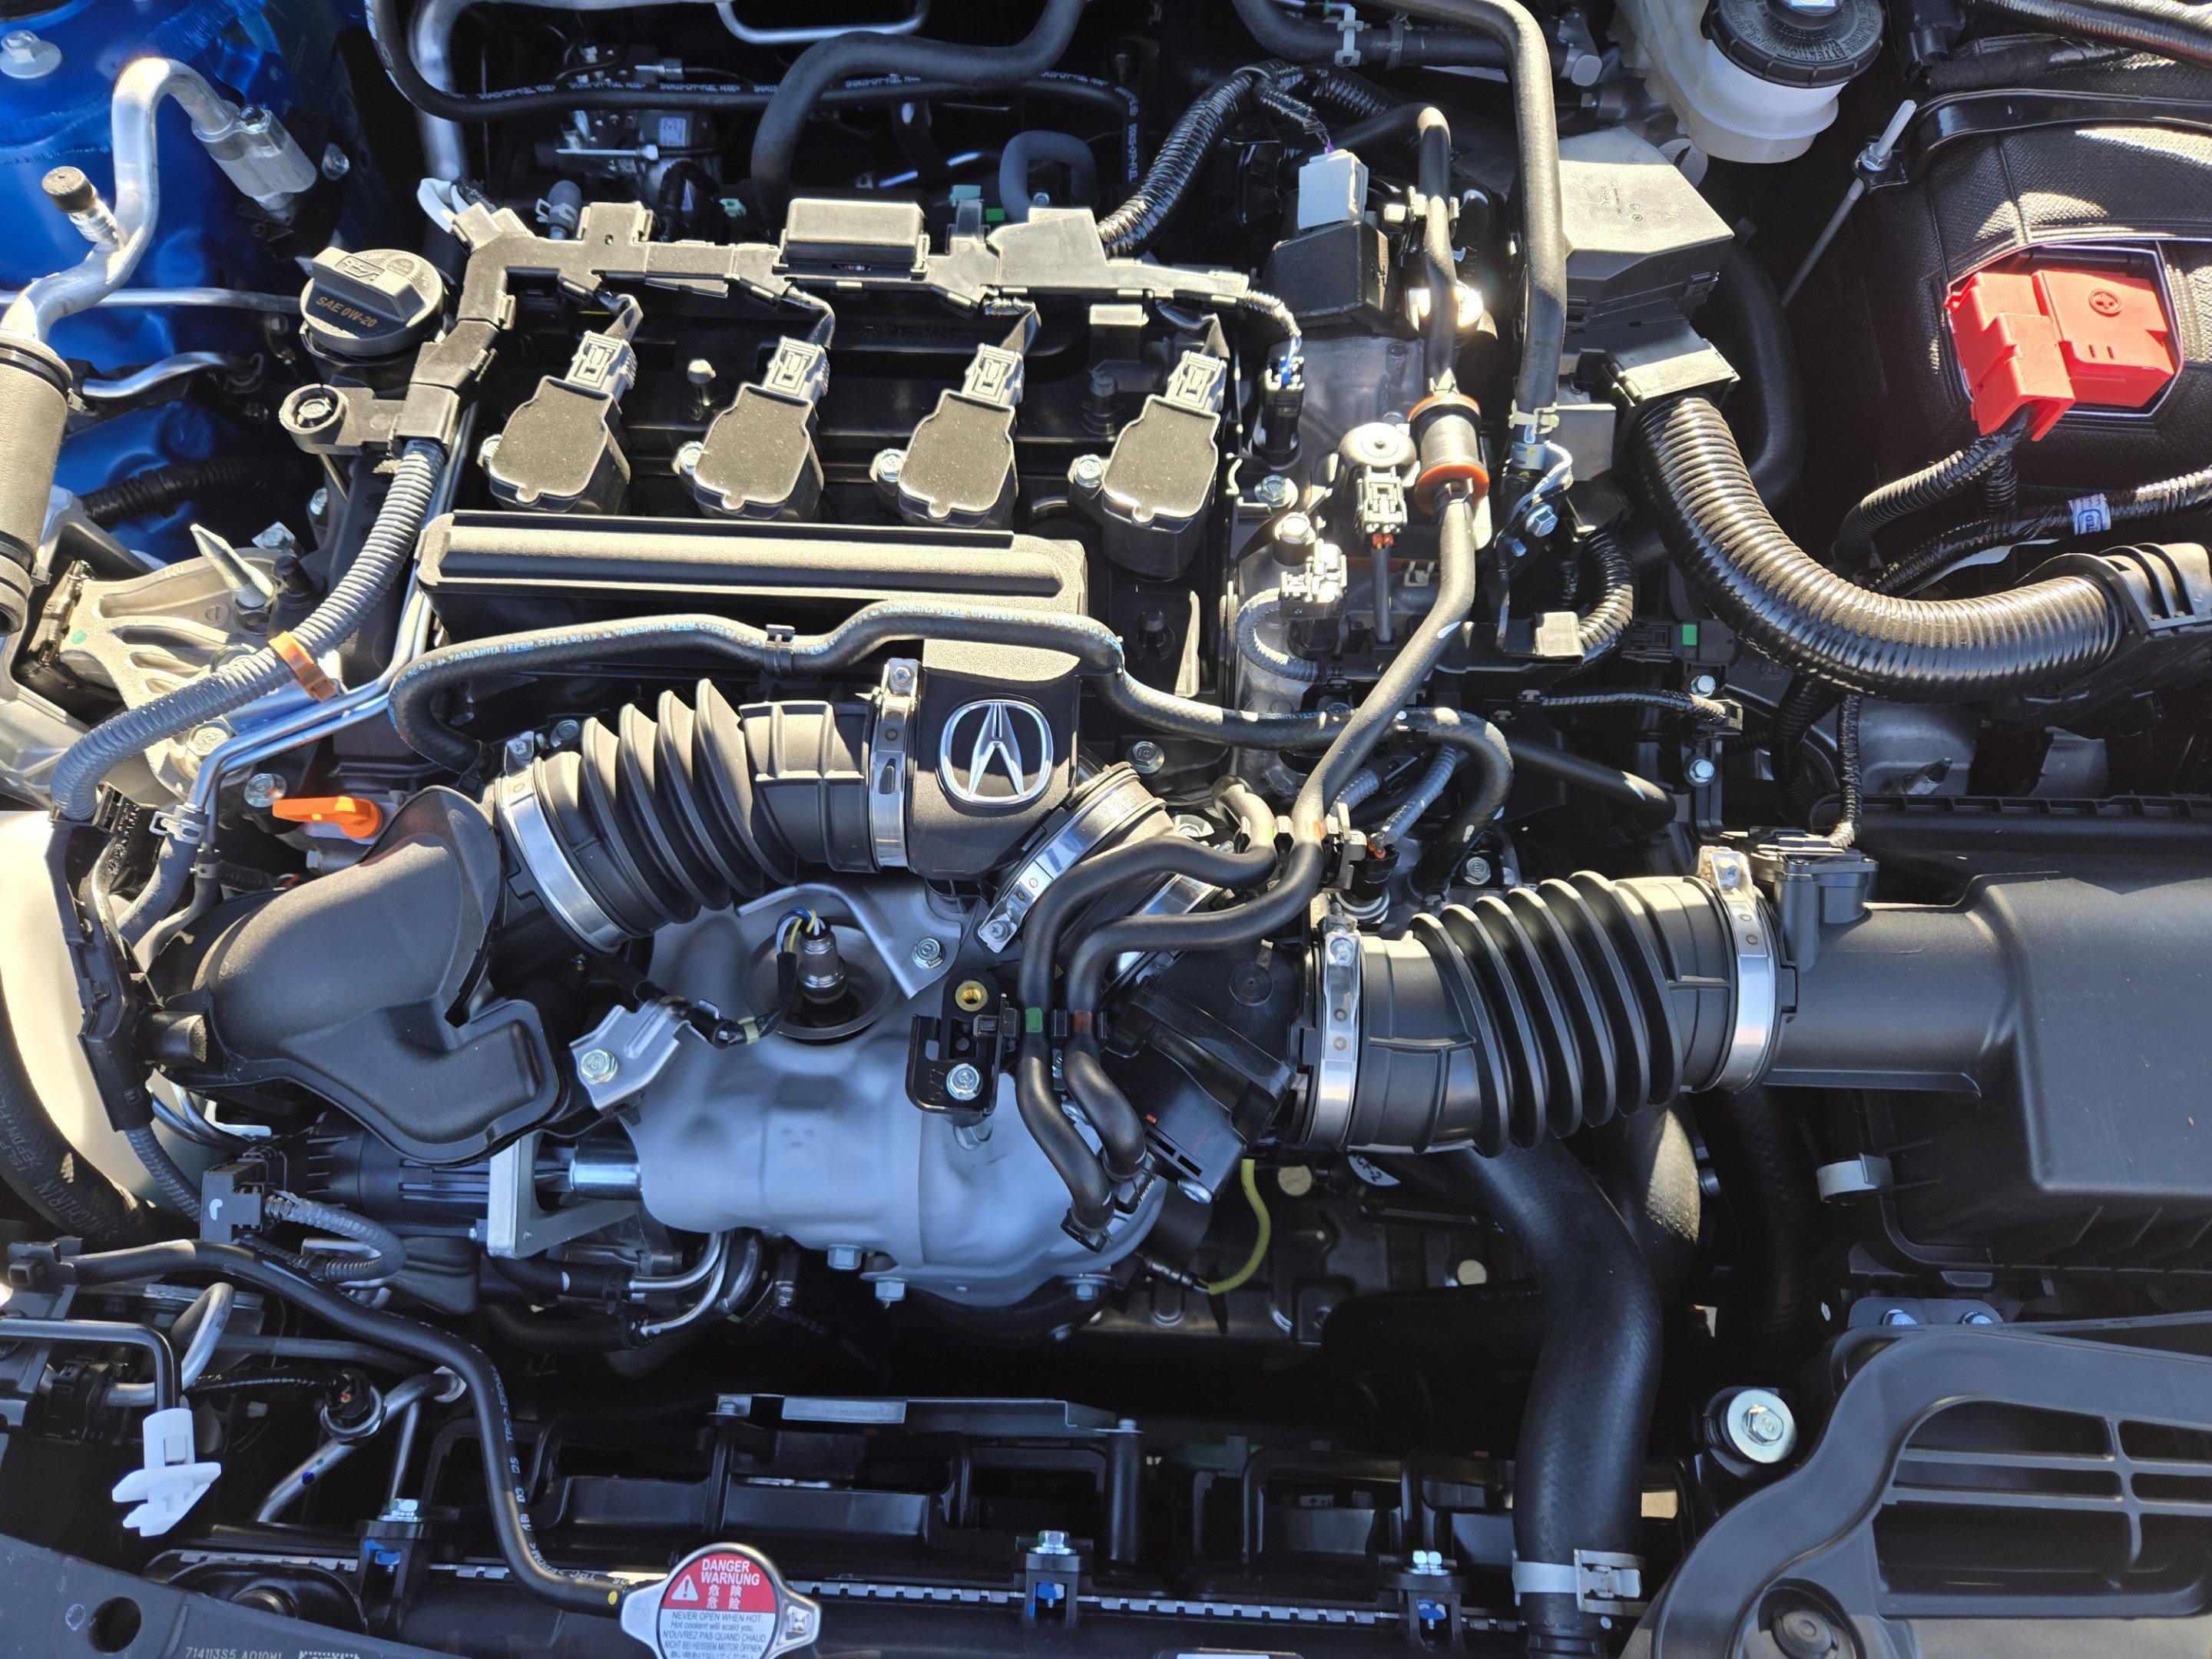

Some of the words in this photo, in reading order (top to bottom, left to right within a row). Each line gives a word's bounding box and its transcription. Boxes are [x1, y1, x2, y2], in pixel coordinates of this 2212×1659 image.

[316, 296, 344, 313] SAE
[340, 307, 379, 328] 0W-20
[882, 606, 935, 614] YAMASHITA
[448, 646, 501, 663] YAMASHITA
[614, 623, 666, 637] YAMASHITA
[701, 1558, 750, 1573] DANGER
[701, 1571, 760, 1586] WARNUNG
[672, 1611, 697, 1621] NEVER
[700, 1612, 720, 1622] OPEN
[722, 1614, 744, 1622] WHEN
[746, 1614, 763, 1624] HOT.
[684, 1621, 707, 1630] coolant
[723, 1623, 739, 1632] scald
[740, 1625, 754, 1634] you.
[663, 1630, 698, 1641] N'OUVREZ
[700, 1631, 714, 1641] PAS
[715, 1632, 740, 1642] QUAND
[185, 1647, 237, 1659] 714113S5
[664, 1641, 681, 1649] NICHT
[682, 1641, 691, 1650] BEI
[692, 1642, 717, 1651] HEISSEM
[717, 1643, 737, 1651] MOTOR
[739, 1642, 763, 1653] ÖFFNEN
